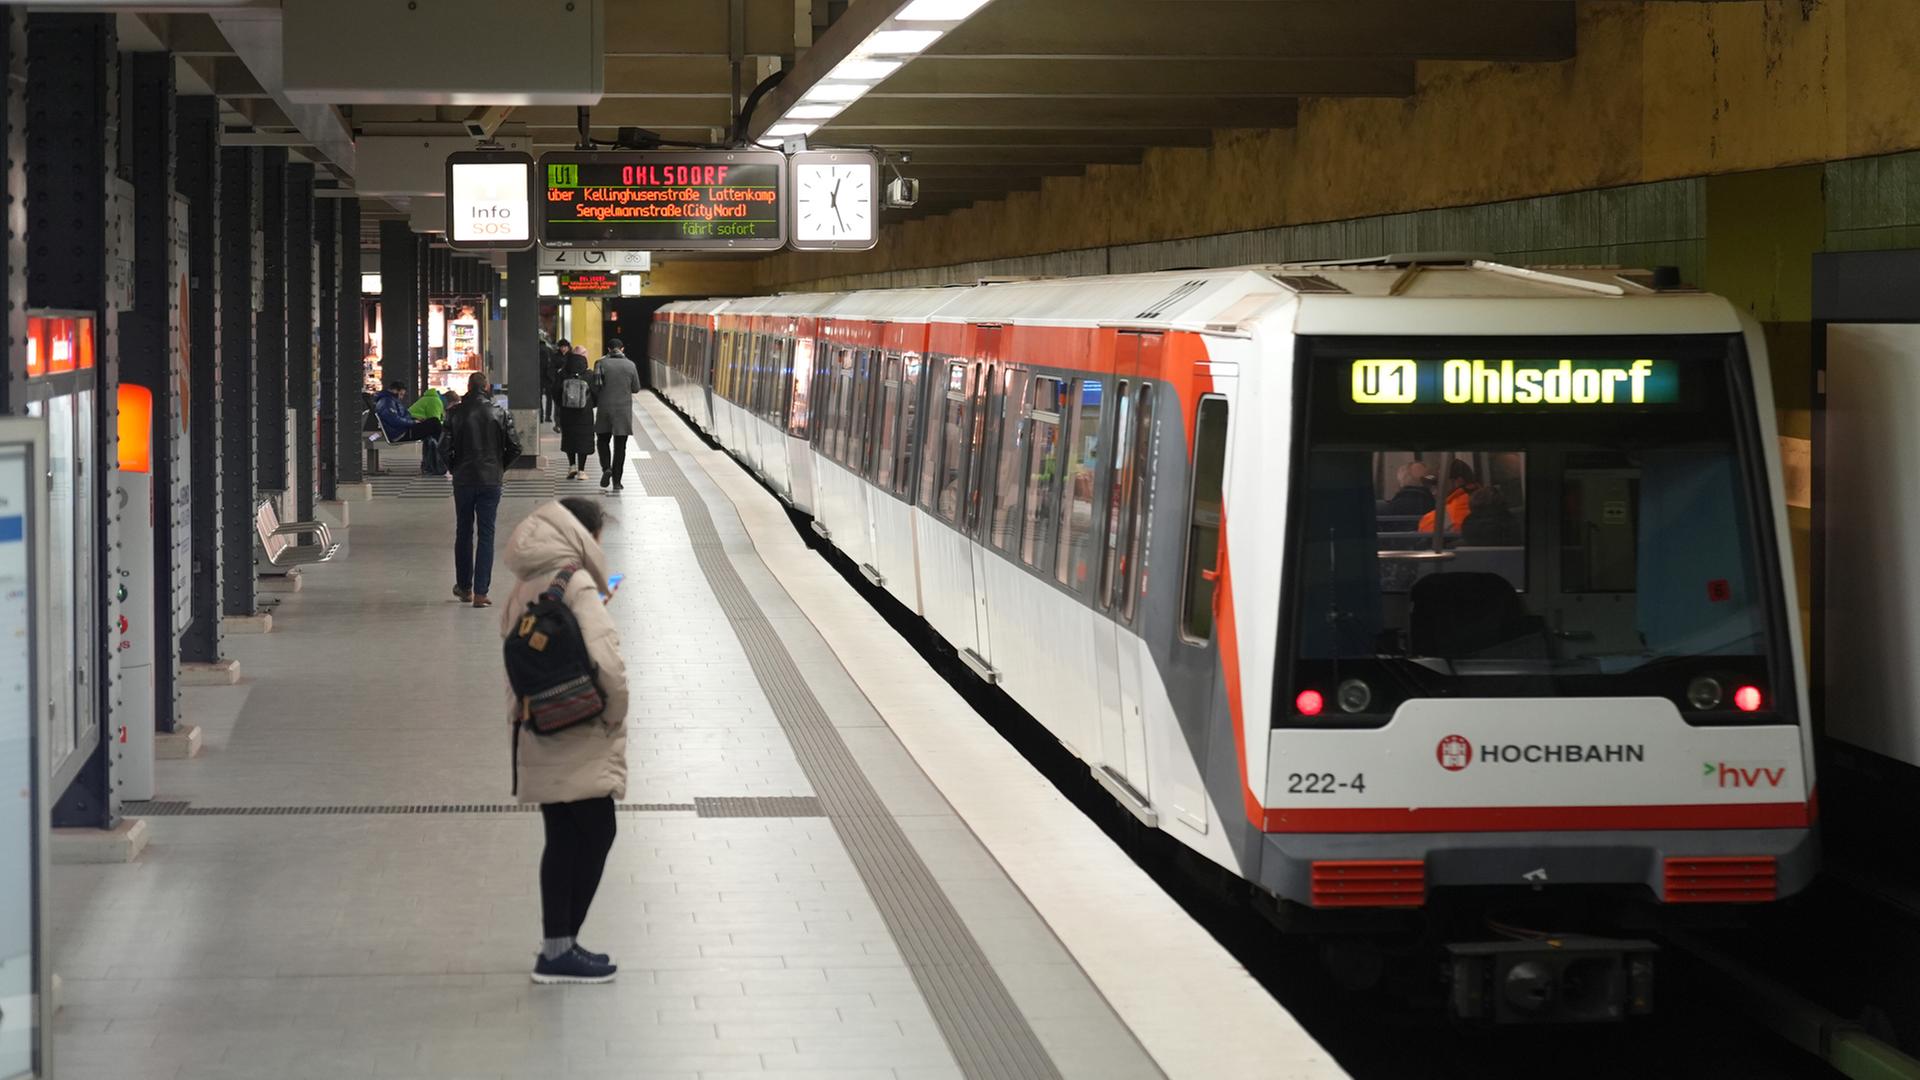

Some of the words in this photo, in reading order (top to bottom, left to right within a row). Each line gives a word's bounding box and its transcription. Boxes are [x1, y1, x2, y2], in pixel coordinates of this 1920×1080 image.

[555, 166, 571, 185] U1
[622, 166, 729, 186] OHLSDORF
[548, 188, 575, 201] über
[584, 188, 700, 205] Kellinghusenstraße
[709, 188, 776, 204] Lattenkamp
[472, 205, 511, 218] Info
[473, 223, 511, 234] SOS
[683, 223, 714, 236] fährt
[717, 223, 756, 236] sofort
[1362, 365, 1403, 396] U1
[1443, 360, 1654, 403] Ohlsdorf
[1480, 744, 1645, 763] HOCHBAHN
[1287, 774, 1367, 794] 222-4
